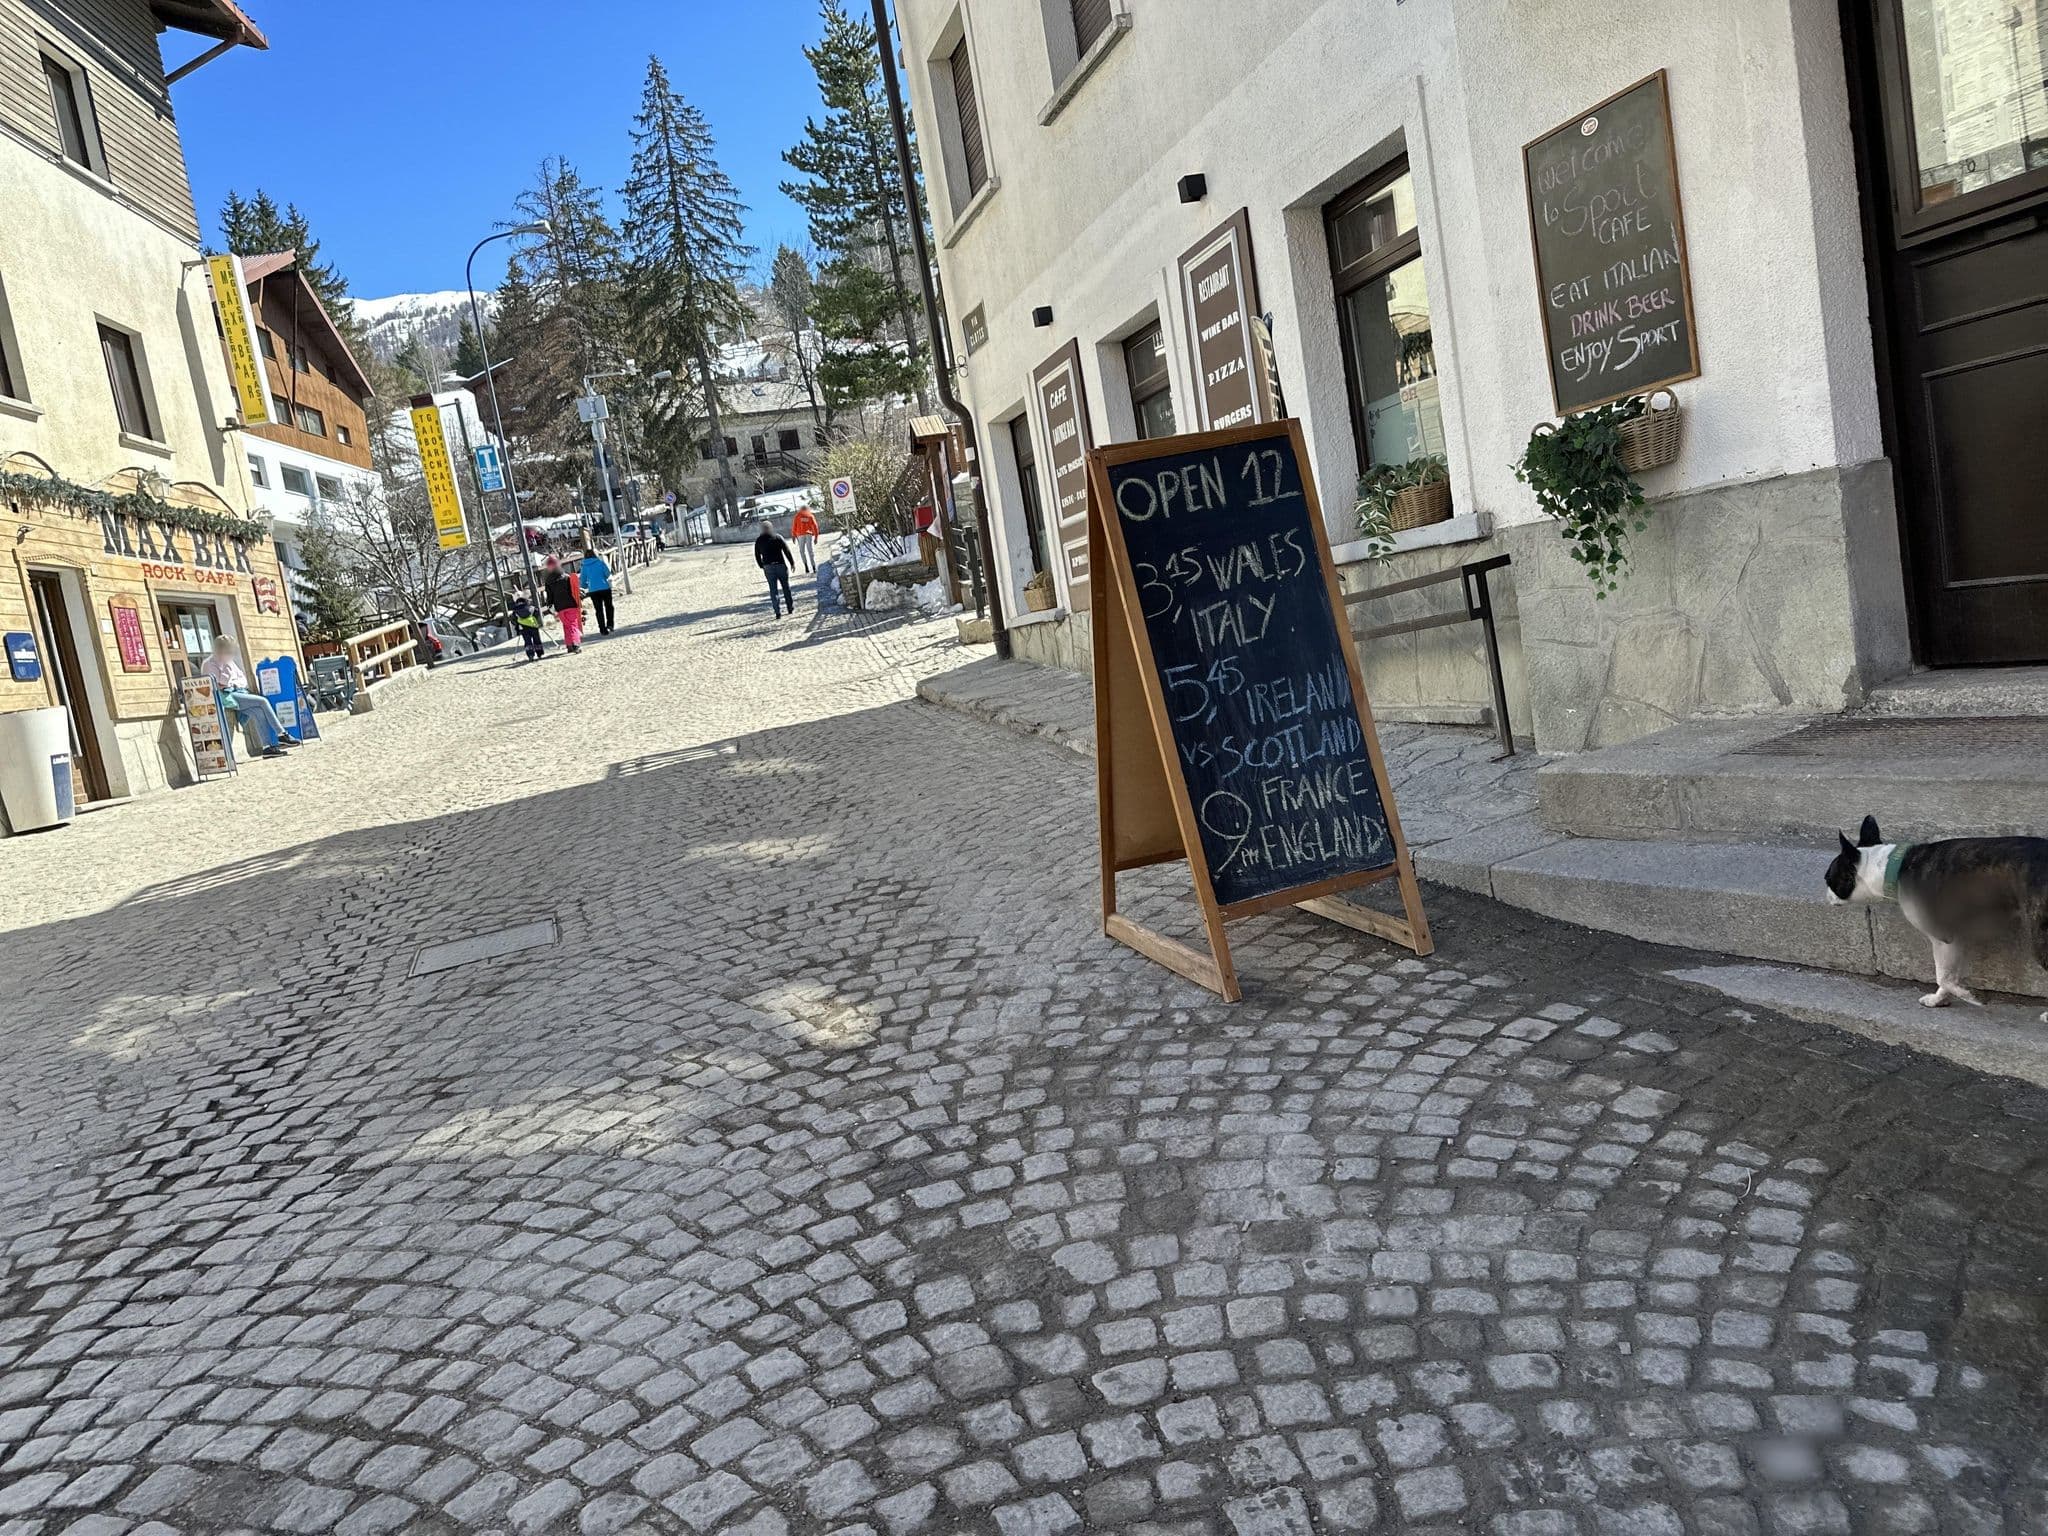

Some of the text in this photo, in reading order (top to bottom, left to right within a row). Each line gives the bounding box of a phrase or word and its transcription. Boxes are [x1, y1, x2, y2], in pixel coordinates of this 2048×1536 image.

[1600, 206, 1652, 245] CAFE
[1198, 264, 1230, 304] RESTAURANT
[1550, 224, 1681, 309] EAT ITALIAN
[220, 270, 255, 399] MAX BAR
[220, 300, 241, 370] BIRRERIA
[226, 261, 245, 323] ENGLISH
[241, 328, 263, 406] BREAKFAST
[1201, 311, 1239, 342] WINE BAR
[1570, 288, 1676, 338] DRINK BEER
[1207, 356, 1246, 387] PIZZA
[1560, 336, 1614, 383] ENJOY
[1050, 384, 1067, 410] CAFE
[1213, 403, 1252, 431] BURGERS
[419, 414, 441, 504] TABACCHI
[426, 413, 449, 503] GIORNALI
[1116, 450, 1302, 522] OPEN 12
[101, 509, 254, 574] MAX BAR
[1207, 528, 1306, 592] WALES
[141, 563, 236, 586] ROCK CAFE
[1190, 593, 1276, 653] ITALY
[1246, 656, 1350, 726] IRELAND
[1221, 717, 1361, 779] SCOTLAND
[1261, 758, 1369, 820] FRANCE
[1201, 790, 1252, 879] 9
[1259, 811, 1384, 871] ENGLAND
